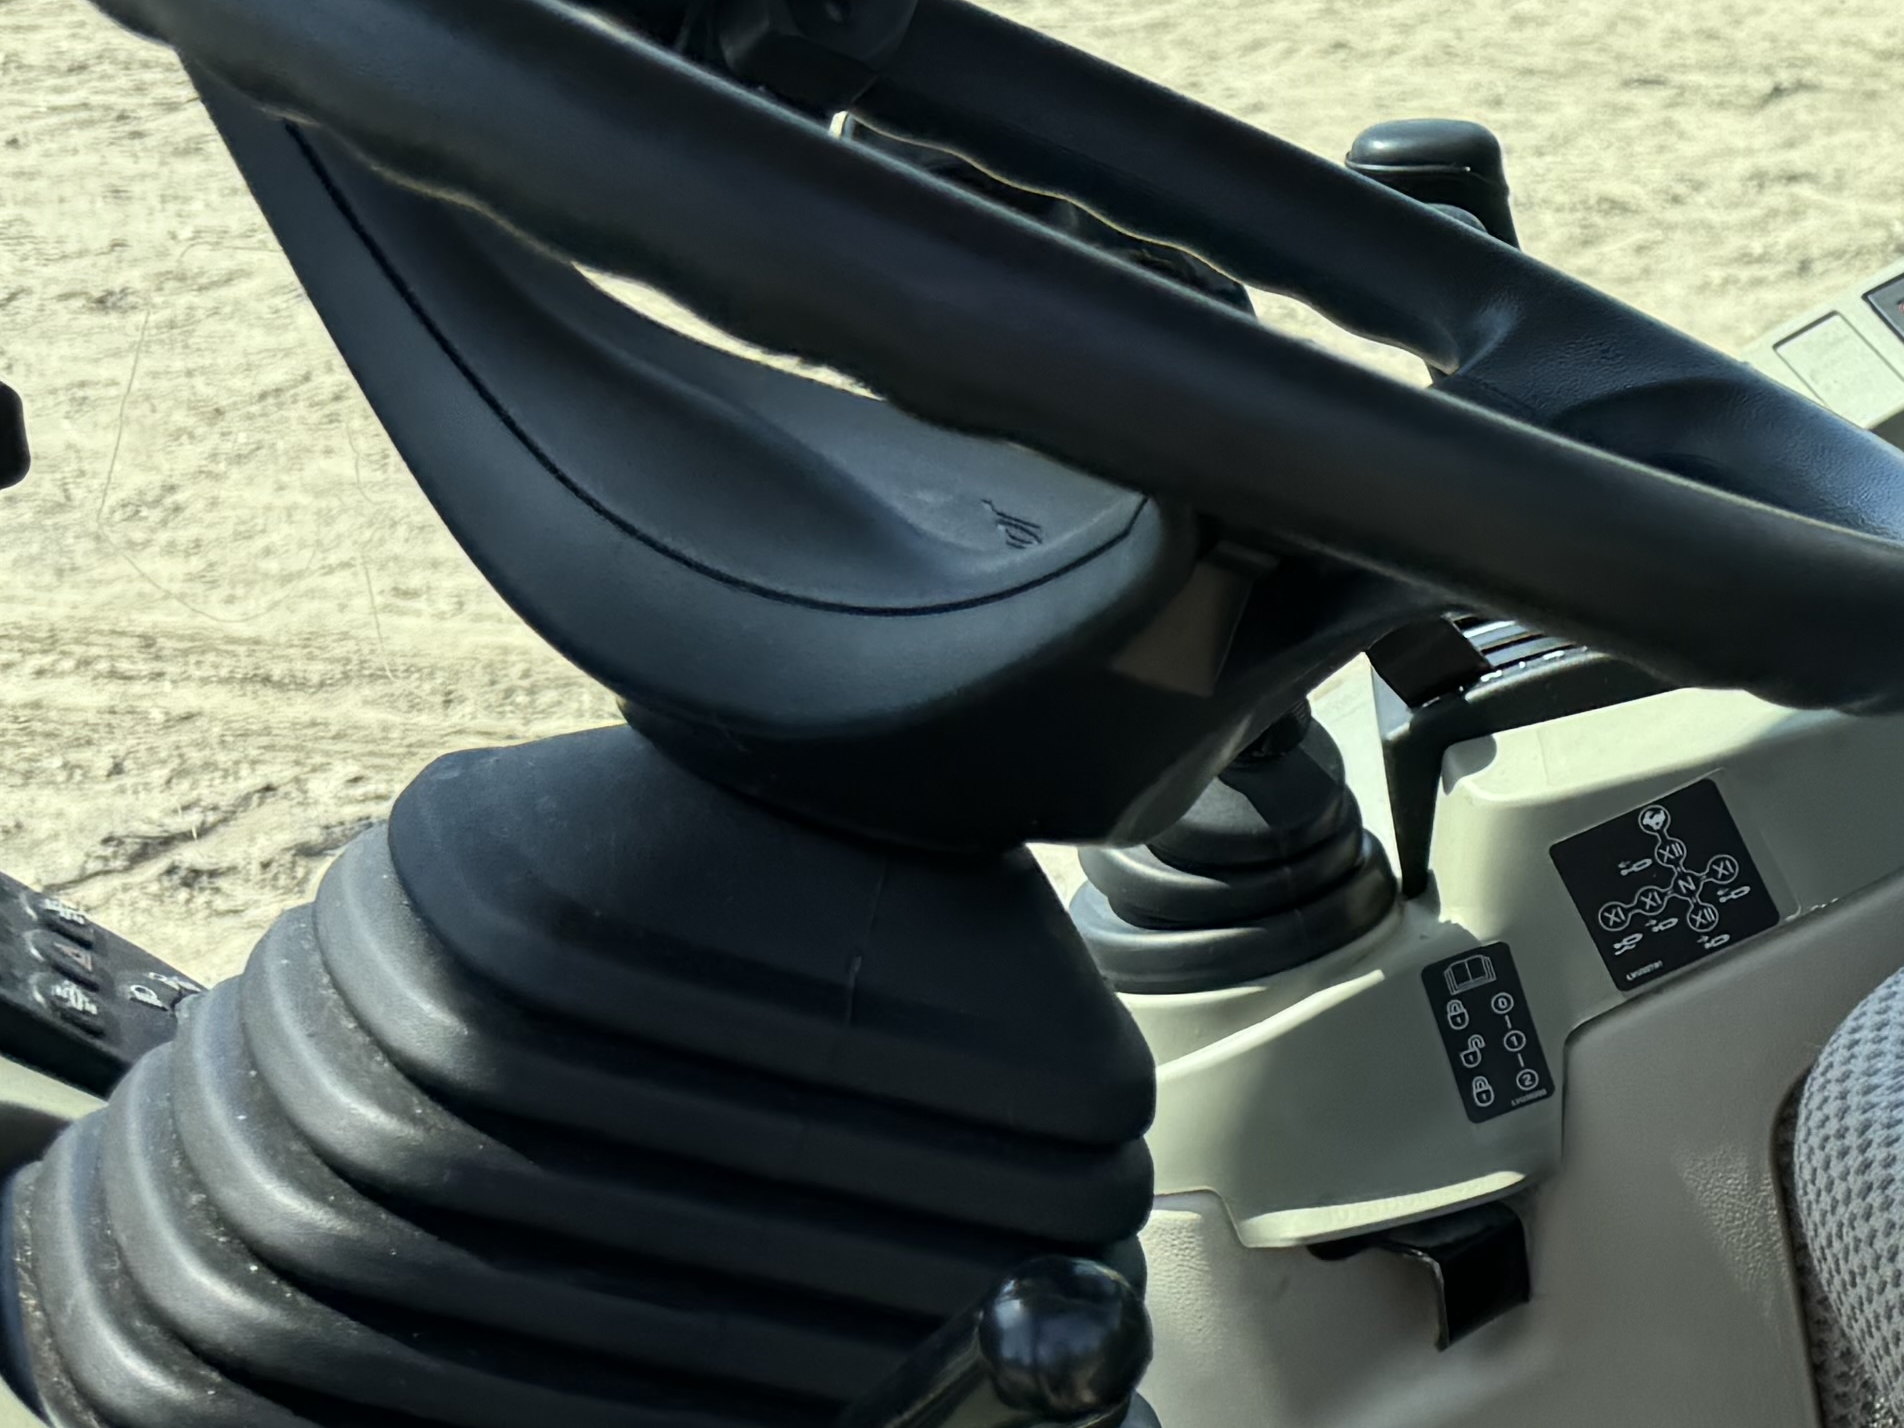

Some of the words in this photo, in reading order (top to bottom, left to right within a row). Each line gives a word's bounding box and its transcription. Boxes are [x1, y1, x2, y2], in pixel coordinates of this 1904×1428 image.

[1659, 843, 1684, 863] XII
[1714, 859, 1734, 879] XI
[1677, 876, 1697, 893] N
[1640, 891, 1660, 910] XI
[1604, 908, 1625, 926] XI
[1691, 907, 1716, 927] XII
